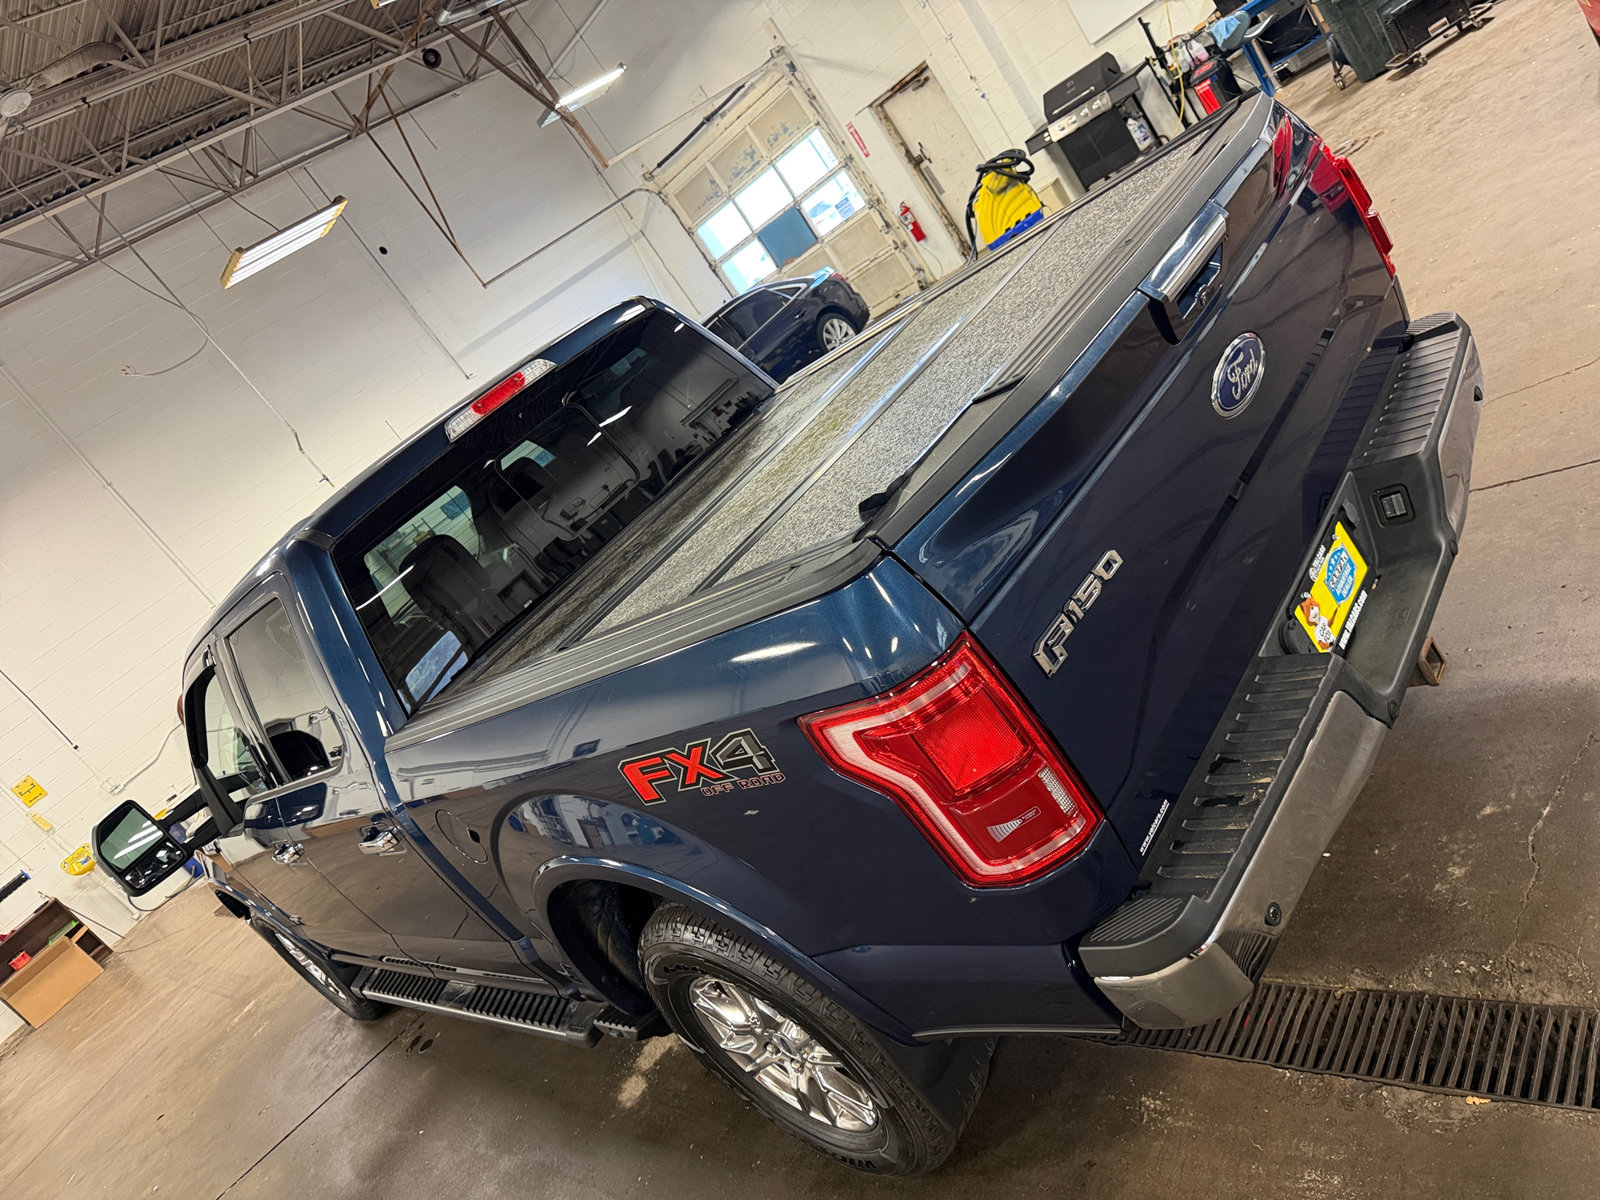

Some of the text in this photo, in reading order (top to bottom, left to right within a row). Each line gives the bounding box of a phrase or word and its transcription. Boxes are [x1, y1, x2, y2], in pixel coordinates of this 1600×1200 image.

[1227, 348, 1258, 400] Ford
[1336, 563, 1352, 595] ADVANTAGE
[1342, 574, 1354, 598] DEALER
[617, 727, 780, 806] FX4
[700, 773, 786, 797] OFF ROAD
